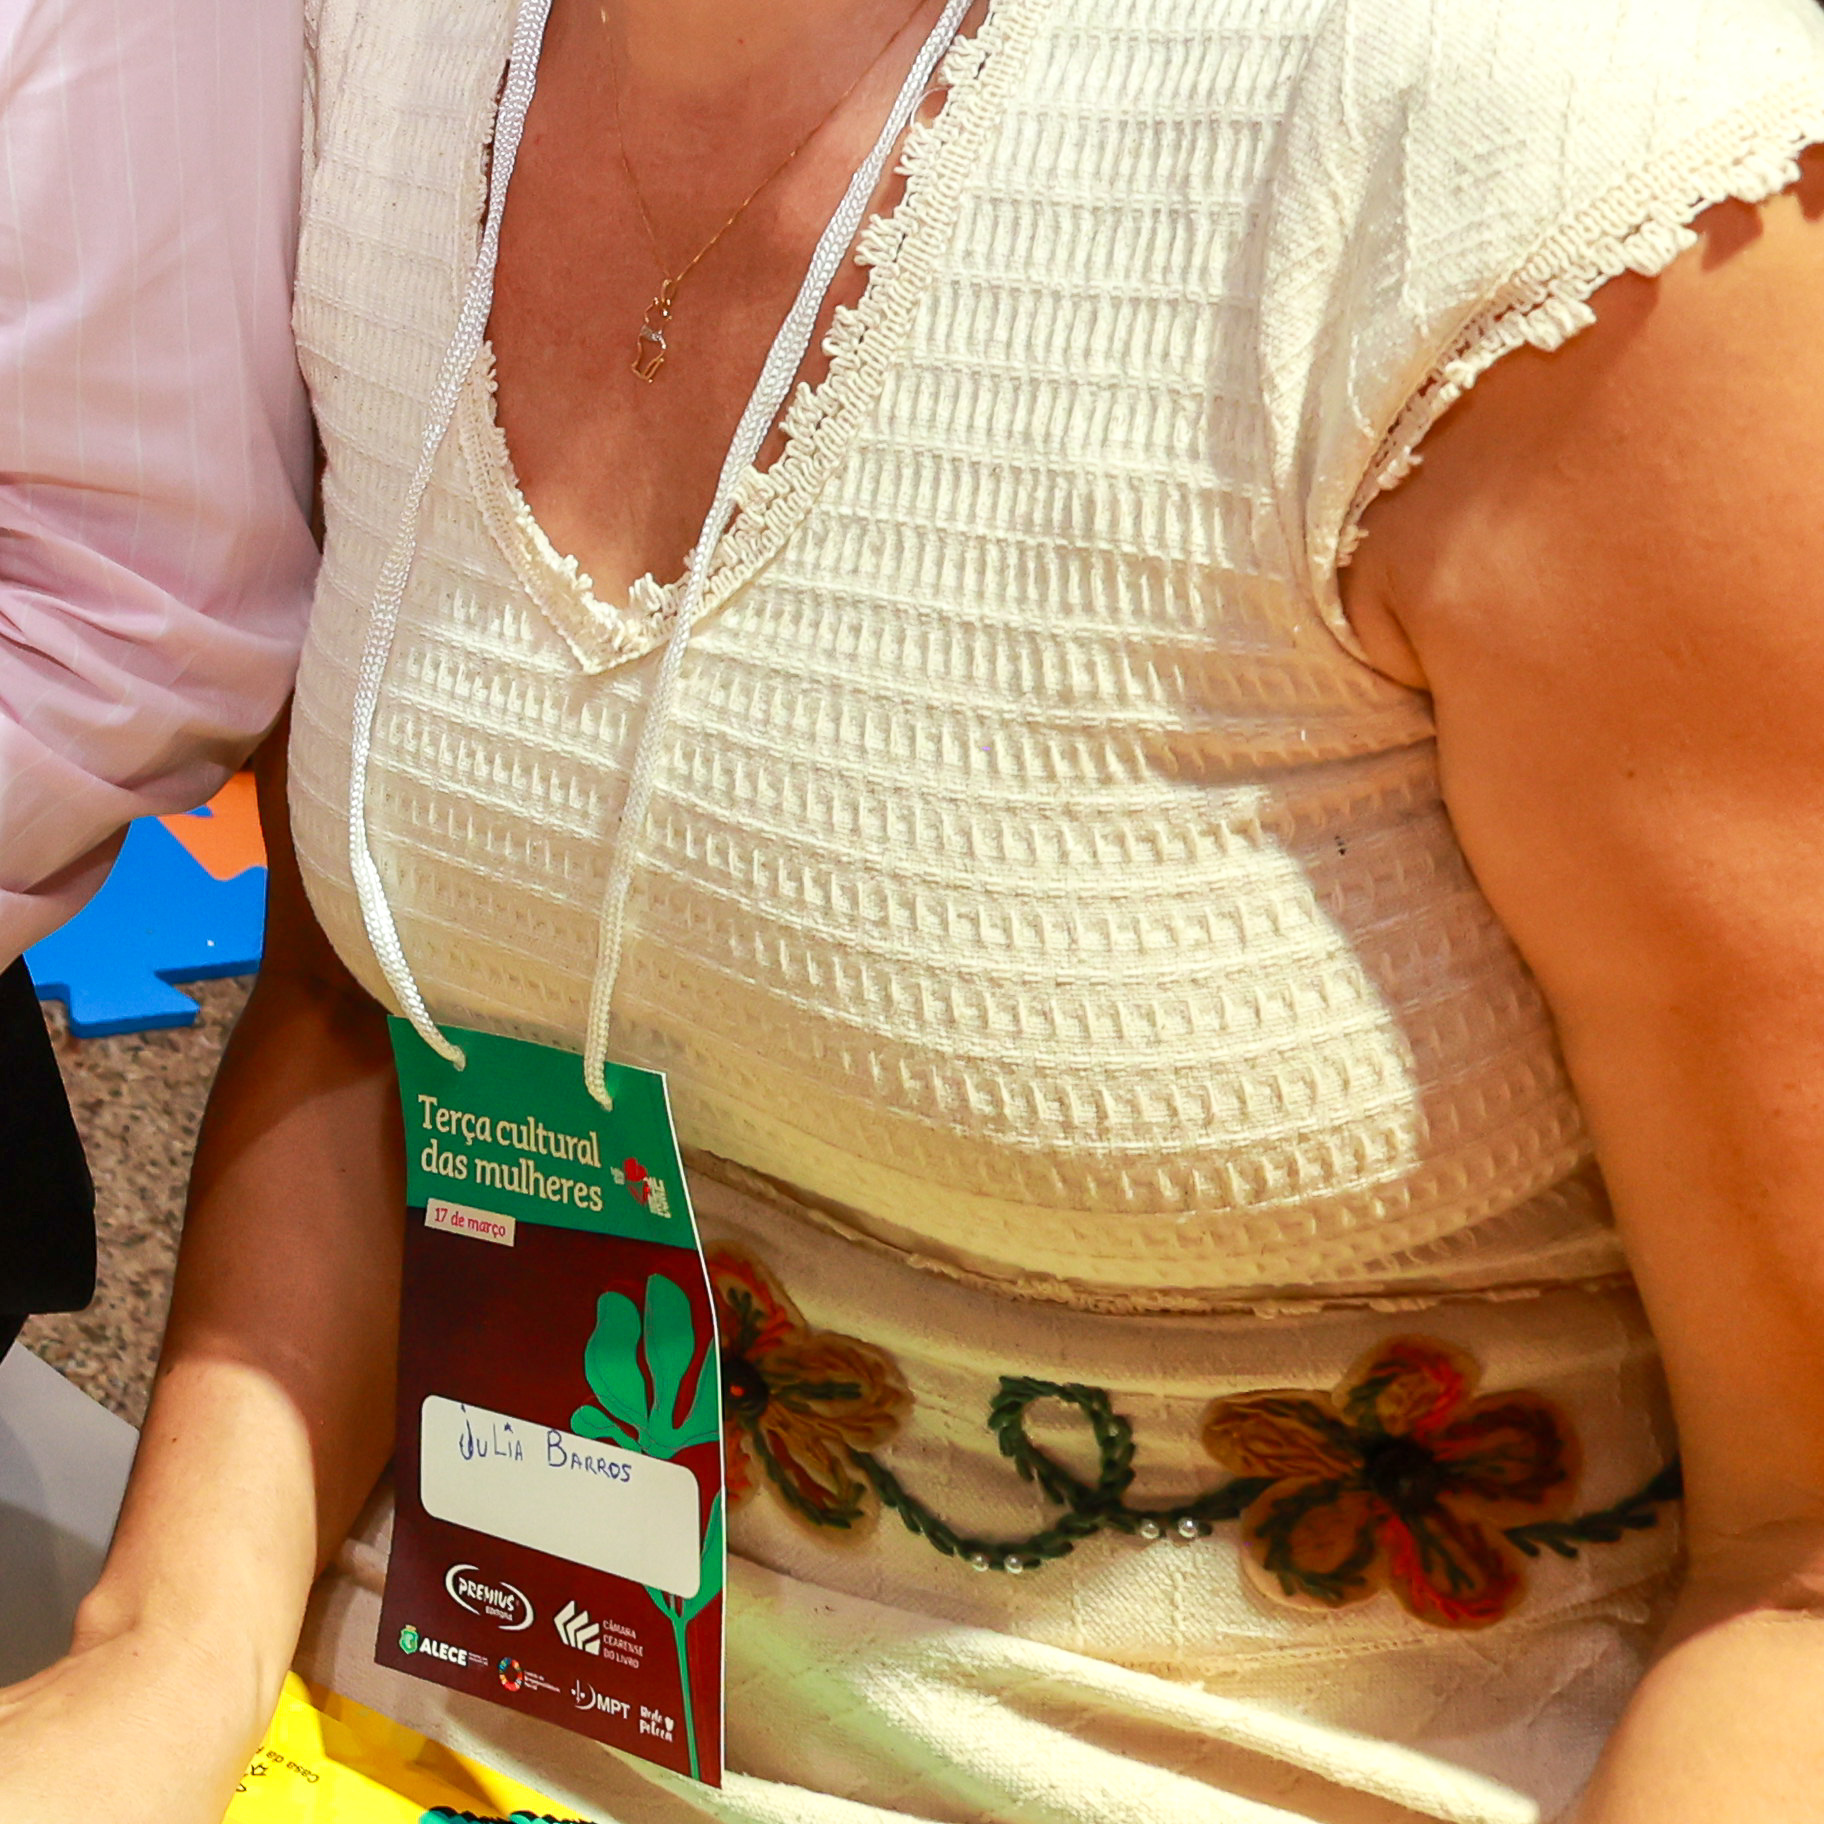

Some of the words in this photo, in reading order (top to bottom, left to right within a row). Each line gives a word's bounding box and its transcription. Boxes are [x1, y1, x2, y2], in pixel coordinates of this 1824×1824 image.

[418, 1094, 492, 1146] Terça
[496, 1116, 601, 1168] cultural
[421, 1138, 468, 1181] das
[475, 1157, 603, 1212] mulheres
[434, 1207, 448, 1223] 17
[451, 1211, 465, 1228] de
[467, 1217, 507, 1238] março
[458, 1576, 515, 1612] PREMIUS
[419, 1637, 468, 1666] ALECE
[603, 1648, 616, 1661] DO
[616, 1650, 640, 1670] LIVRO
[597, 1693, 631, 1720] MPT
[266, 1750, 285, 1763] da
[286, 1761, 320, 1784] Casa
